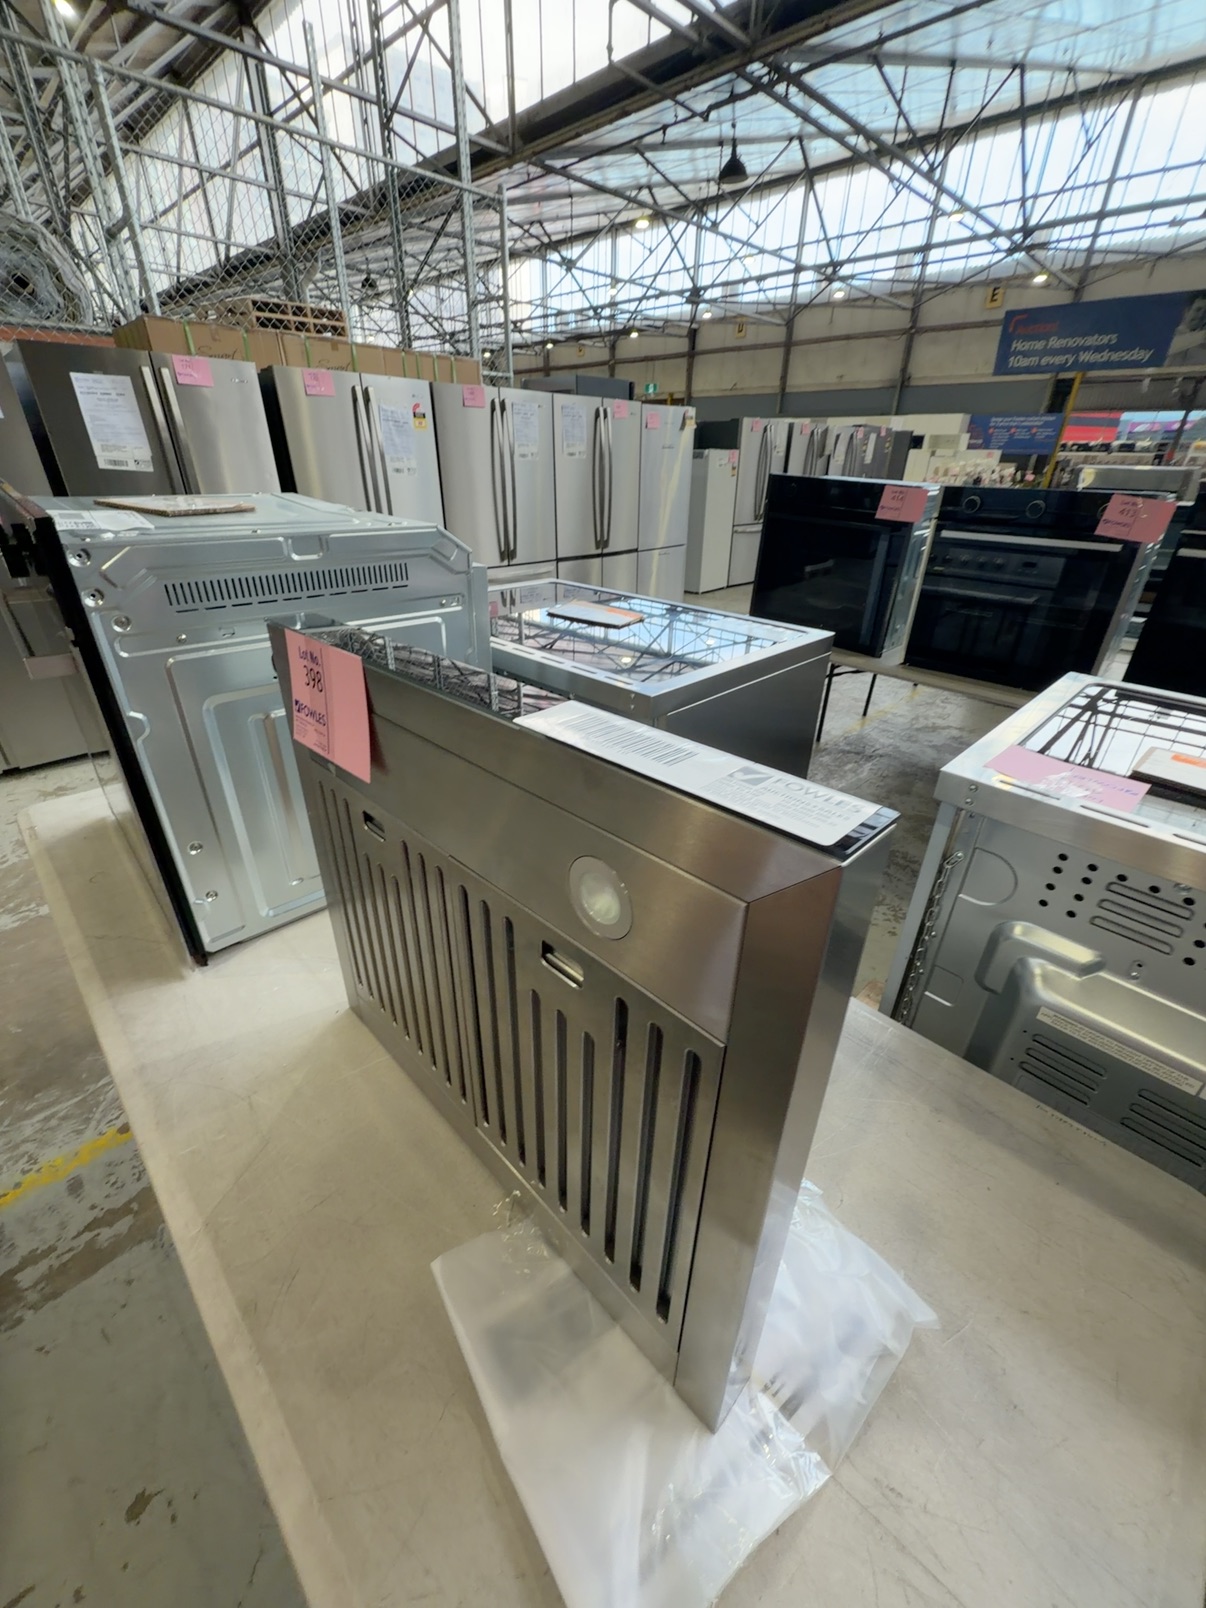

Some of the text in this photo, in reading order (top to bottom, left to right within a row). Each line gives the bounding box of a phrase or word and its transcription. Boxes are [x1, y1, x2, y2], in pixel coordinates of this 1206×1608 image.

[991, 286, 1001, 302] E
[1011, 333, 1118, 351] Home Renovators
[1008, 347, 1154, 368] 10am every Wednesday
[299, 646, 310, 662] Lot
[303, 665, 323, 693] 398
[300, 704, 326, 727] FOWLES
[773, 777, 866, 814] FOWLES
